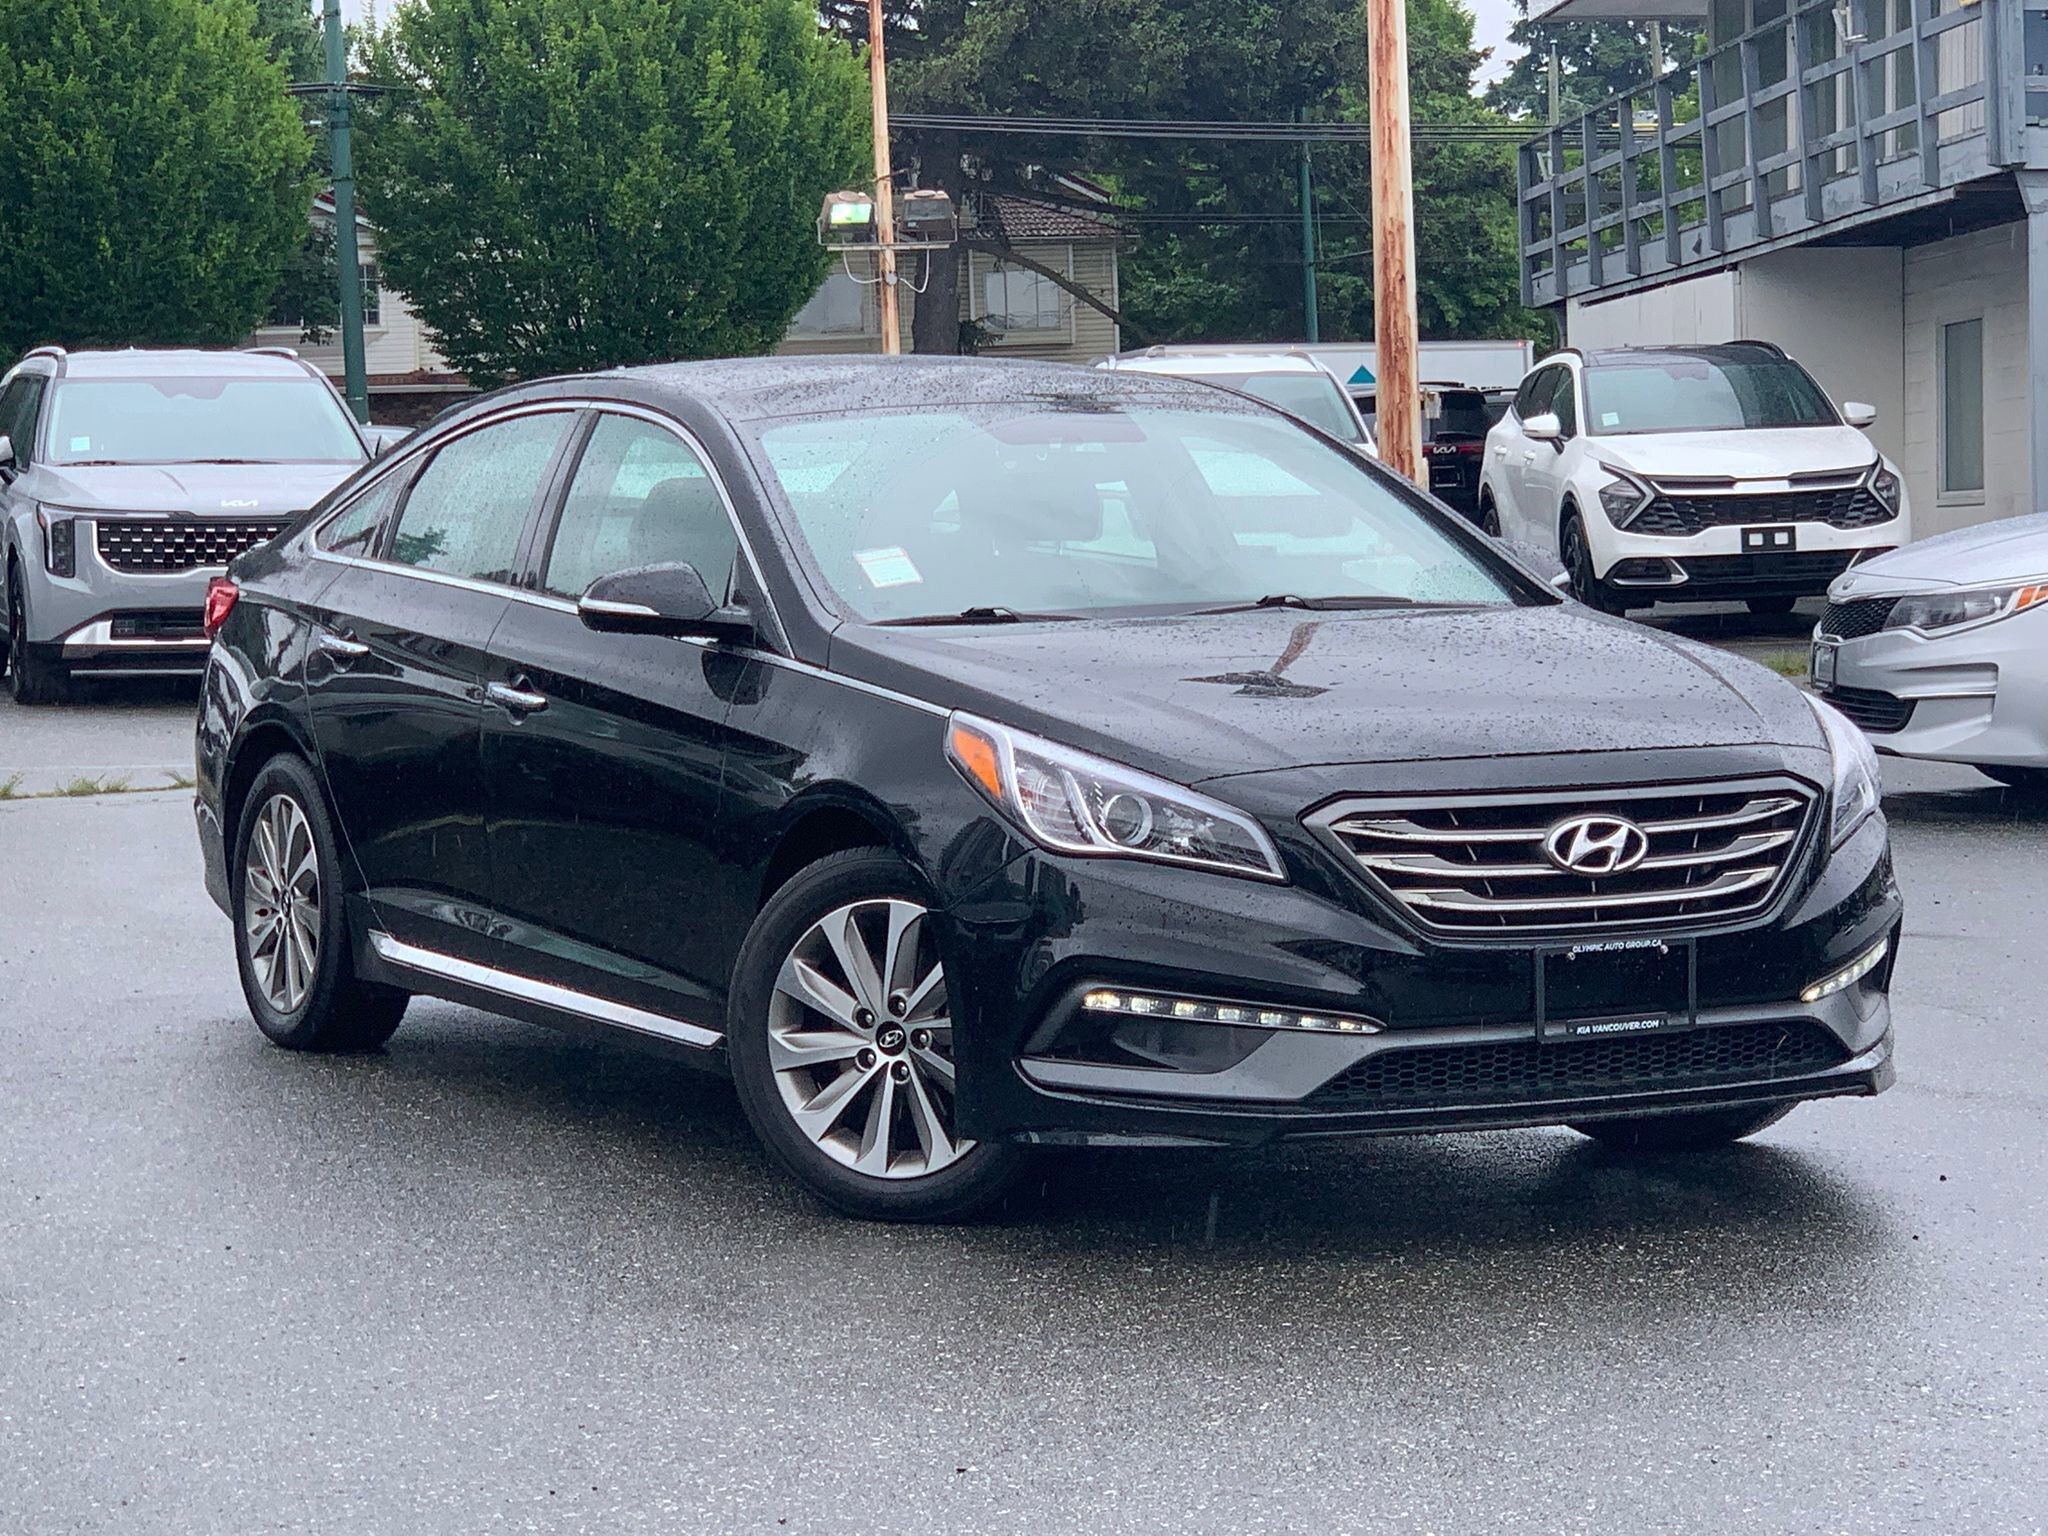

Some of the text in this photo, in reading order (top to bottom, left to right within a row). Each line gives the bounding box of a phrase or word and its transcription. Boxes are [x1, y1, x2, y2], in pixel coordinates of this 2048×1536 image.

[1572, 939, 1662, 953] OLYMPIC AUTO GROUP.CA
[1576, 1020, 1659, 1035] KIA VANCOUVER.COM
